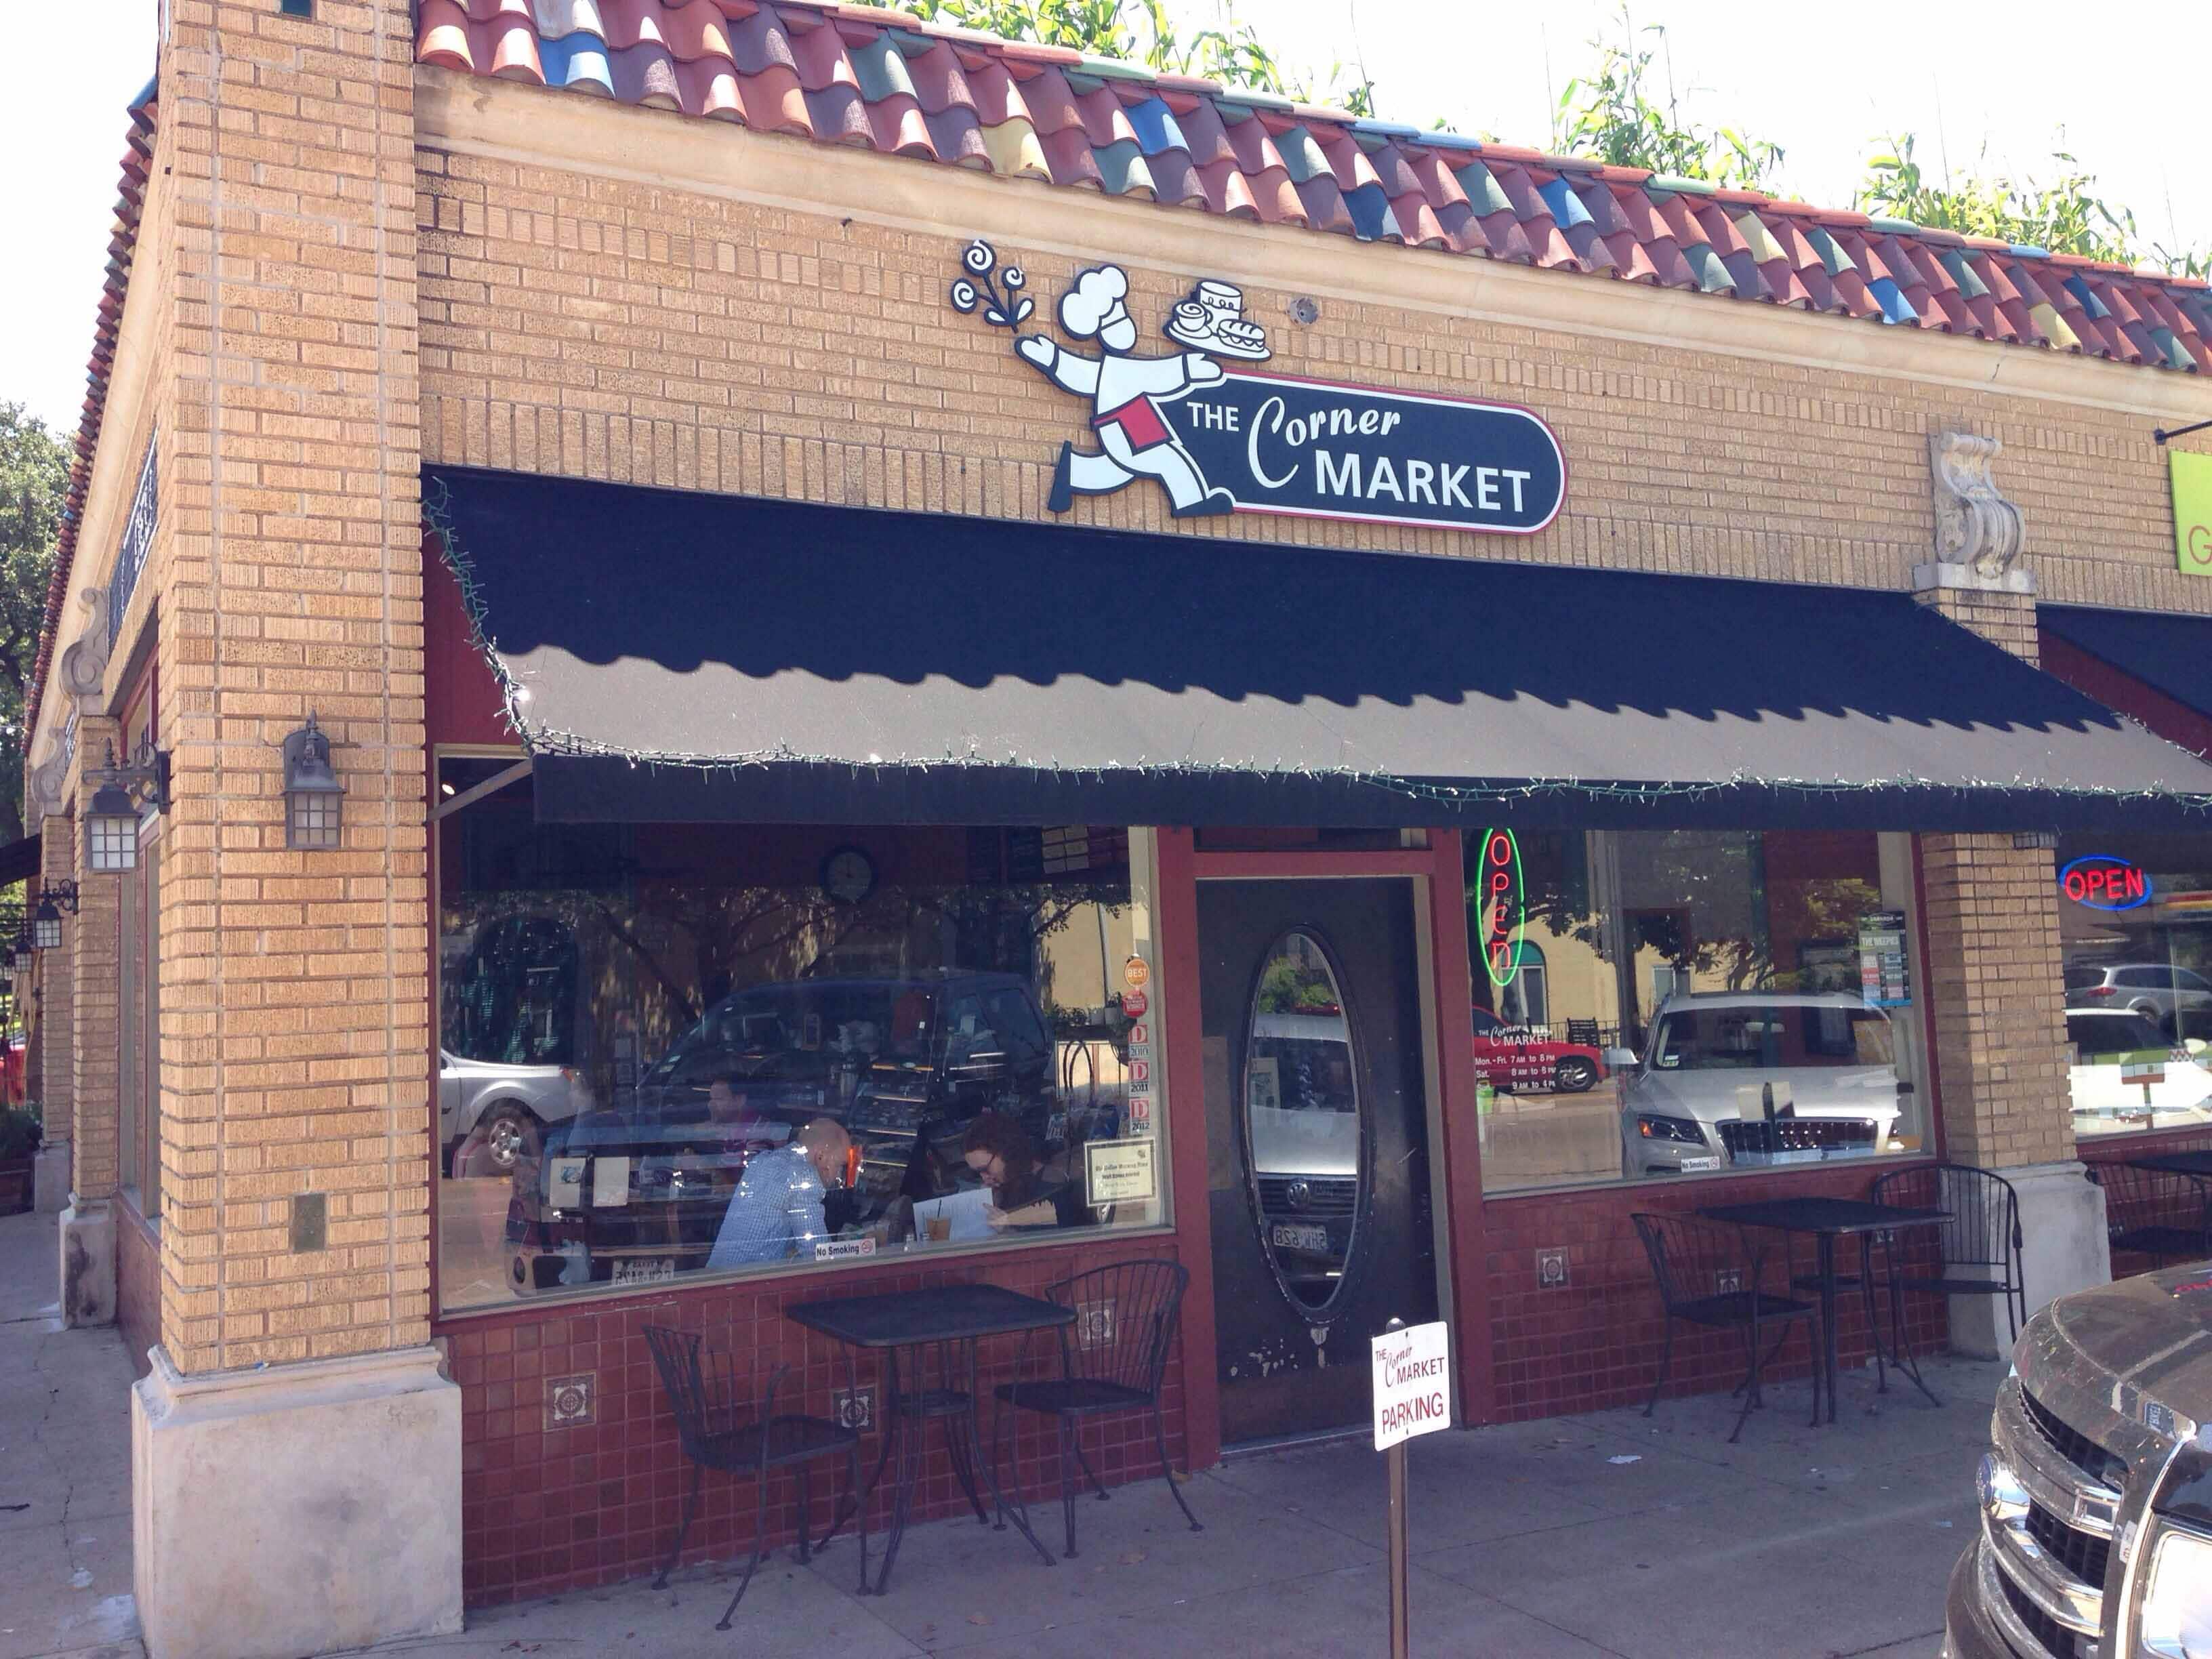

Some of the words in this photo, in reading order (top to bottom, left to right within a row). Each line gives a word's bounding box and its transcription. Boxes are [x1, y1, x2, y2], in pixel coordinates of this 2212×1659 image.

[1187, 401, 1240, 432] THE
[1248, 396, 1401, 489] Corner
[1315, 449, 1531, 512] MARKET
[2066, 867, 2144, 901] OPEN
[1127, 968, 1147, 977] BEST
[1490, 1025, 1521, 1047] Corner
[1504, 1034, 1550, 1046] MARKET
[1130, 1046, 1149, 1057] 2010
[1531, 1067, 1538, 1076] to
[1130, 1084, 1149, 1092] 2011
[1132, 1122, 1149, 1130] 2012
[817, 1247, 826, 1256] No
[828, 1245, 859, 1255] Smoking
[1376, 1348, 1387, 1361] THE
[1385, 1346, 1412, 1388] Corner
[1397, 1357, 1445, 1385] MARKET
[1382, 1391, 1443, 1435] PARKING
